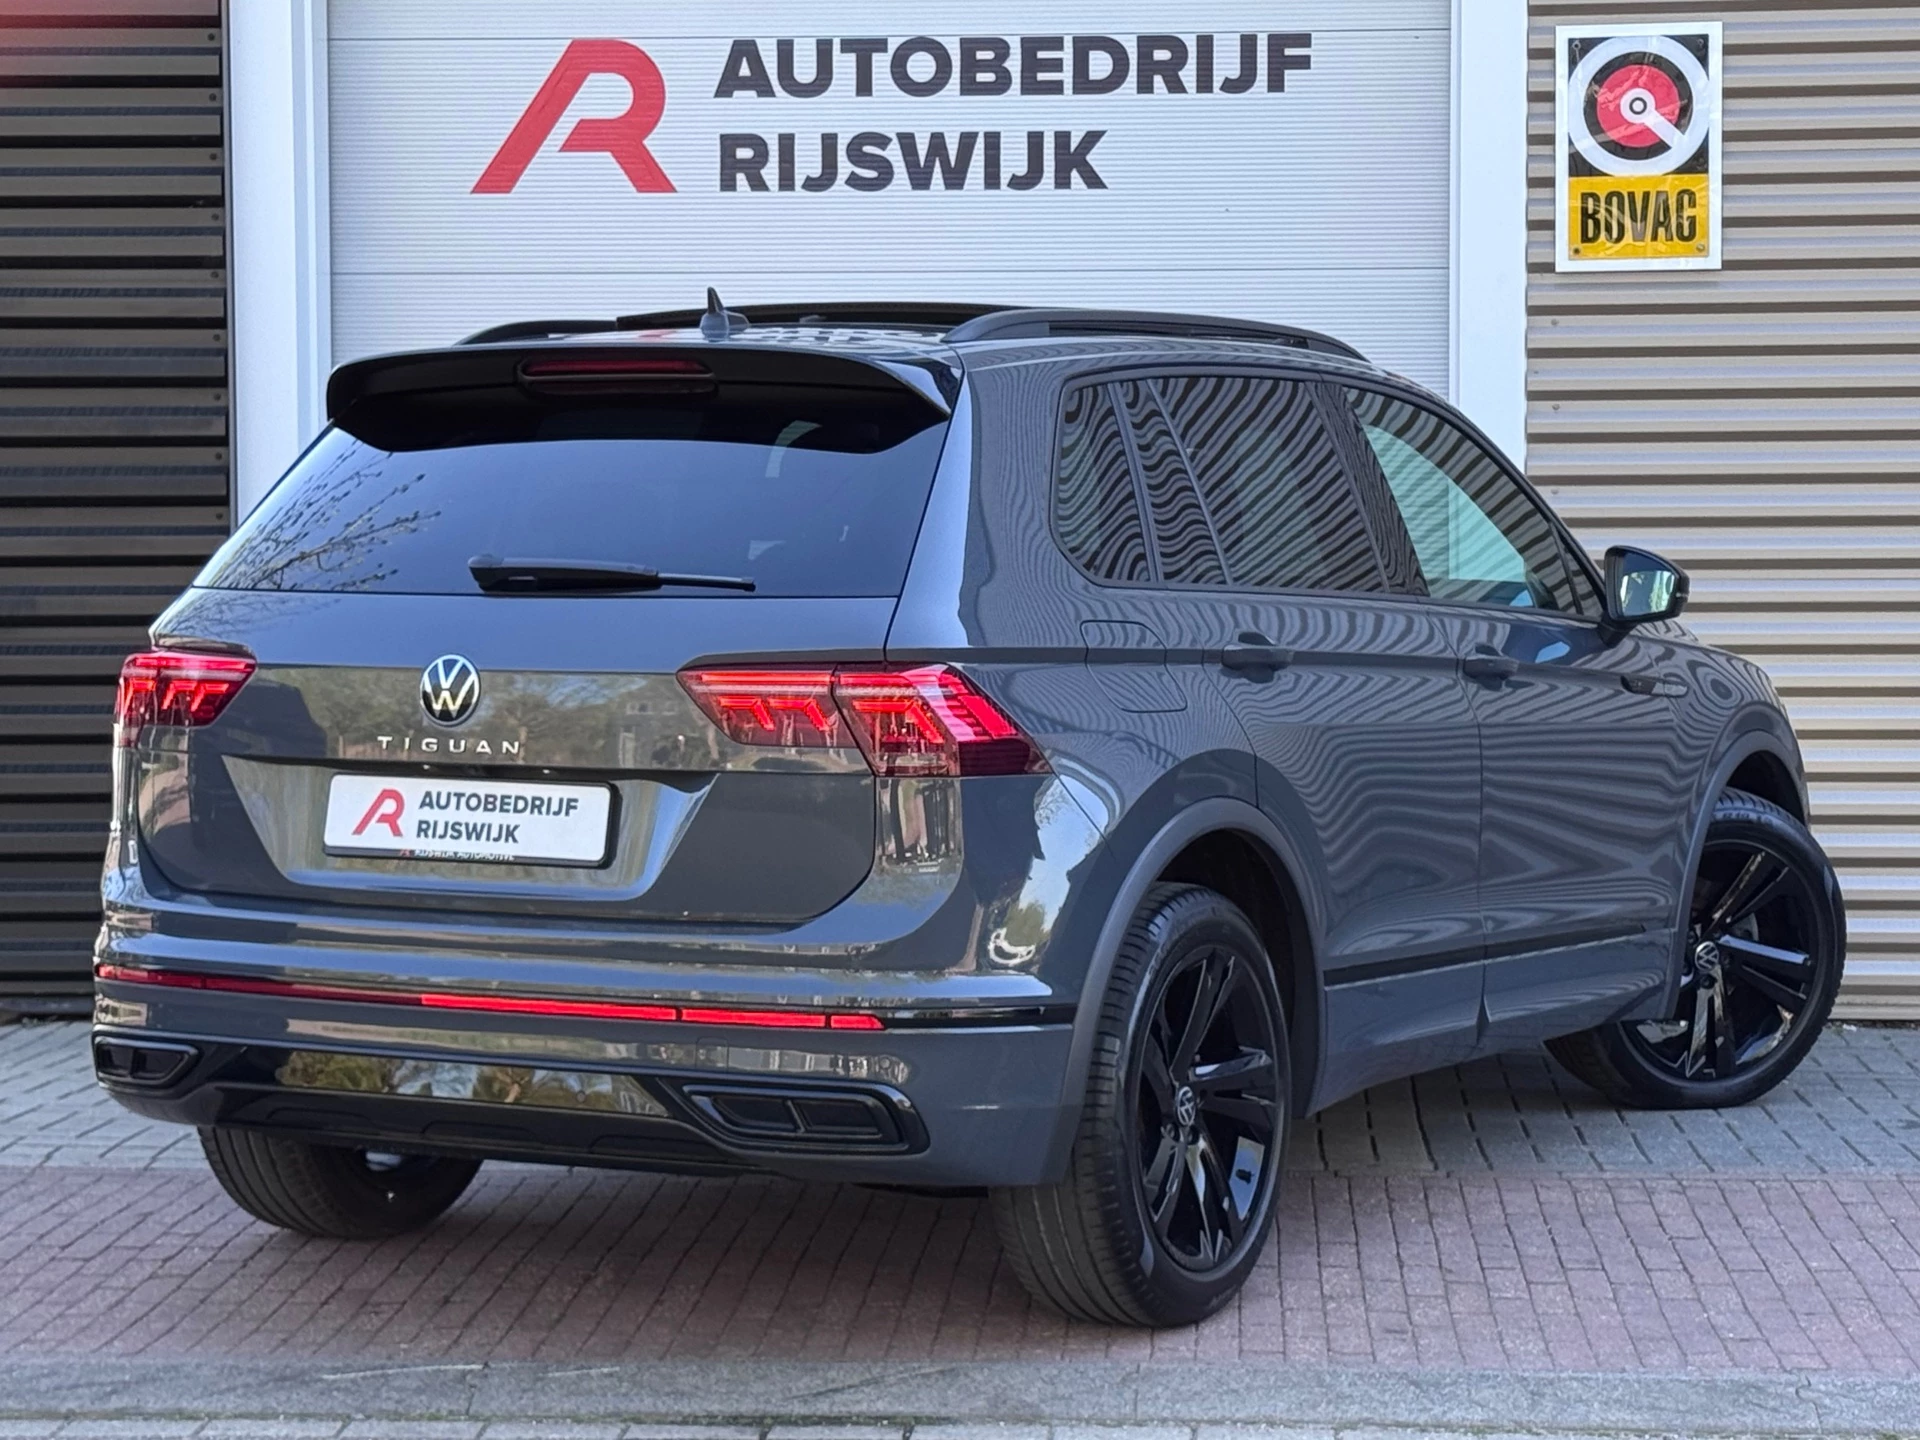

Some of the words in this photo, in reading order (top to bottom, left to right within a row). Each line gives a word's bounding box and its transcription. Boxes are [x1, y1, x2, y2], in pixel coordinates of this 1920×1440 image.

[713, 32, 1312, 98] AUTOBEDRIJF
[718, 129, 1108, 193] RIJSWIJK
[1580, 189, 1697, 244] BOVAG
[377, 735, 520, 755] TIGUAN
[418, 790, 579, 817] AUTOBEDRIJF
[416, 820, 520, 844] RIJSWIJK
